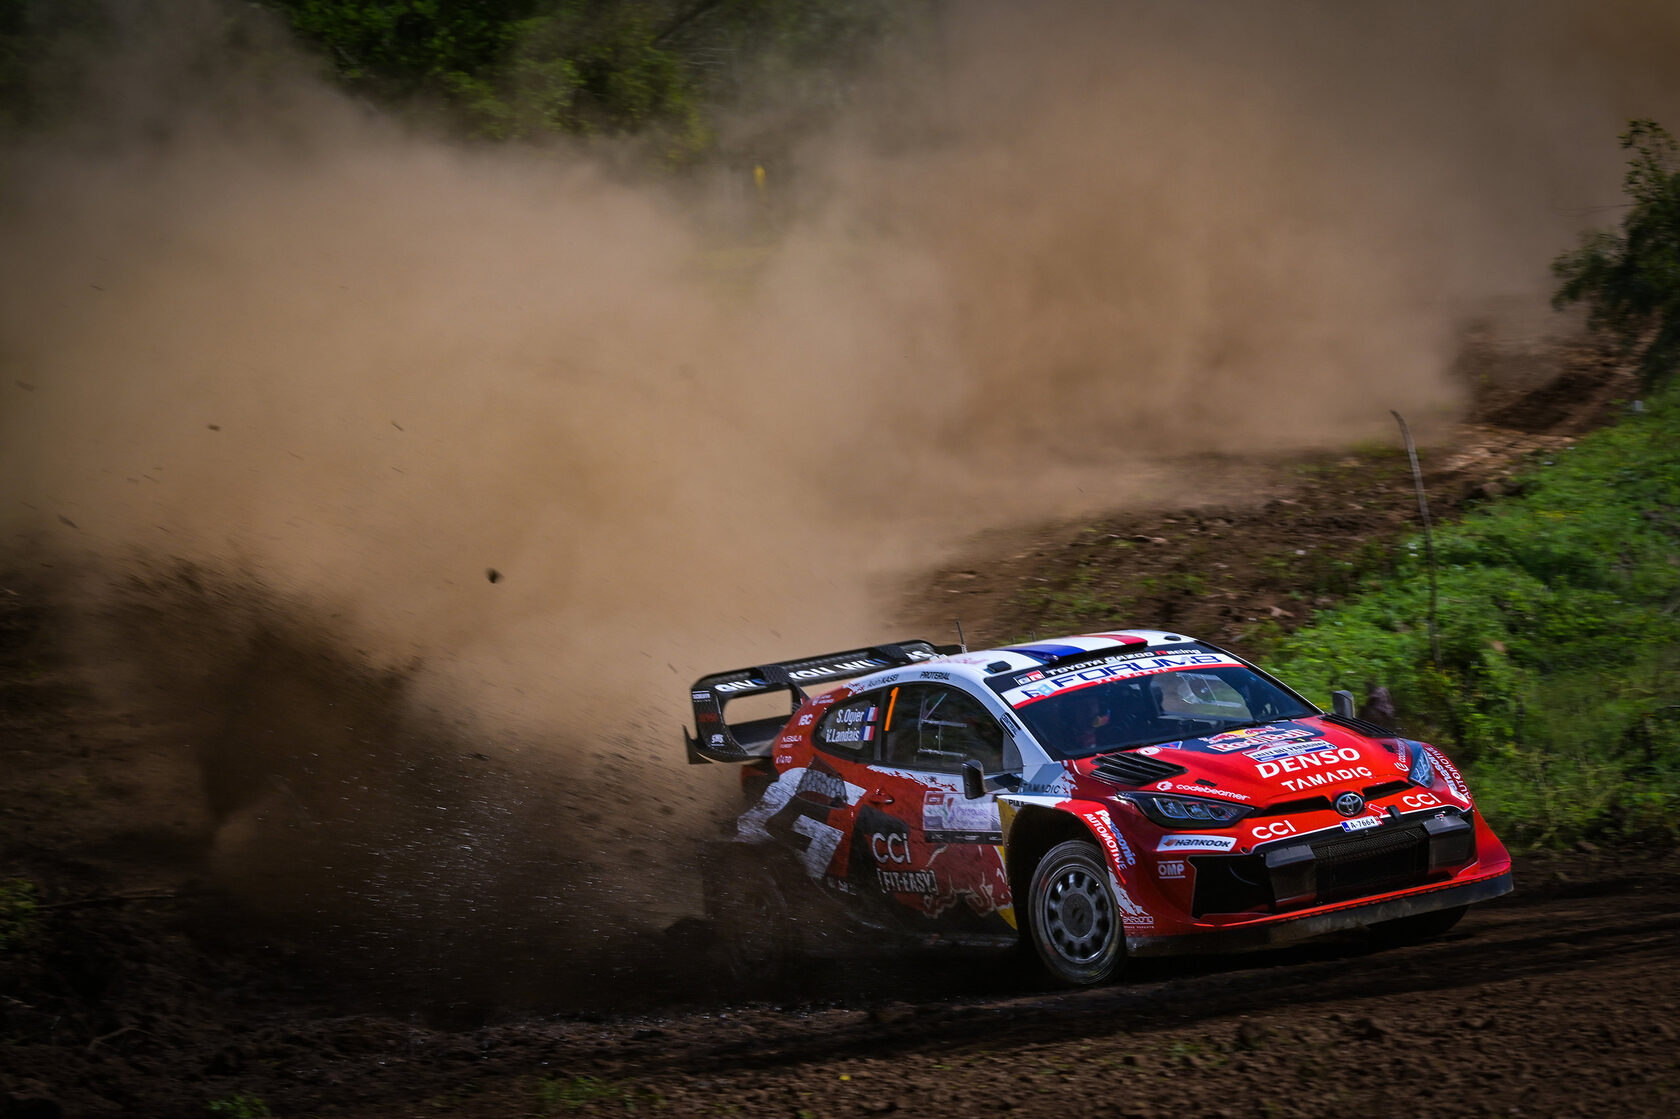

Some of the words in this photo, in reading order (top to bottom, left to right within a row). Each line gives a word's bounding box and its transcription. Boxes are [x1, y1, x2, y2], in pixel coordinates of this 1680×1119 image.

[1045, 660, 1101, 676] TOYOTA
[1050, 654, 1223, 688] FORUM8
[884, 686, 900, 732] 1
[1207, 735, 1262, 752] Red
[1261, 728, 1316, 743] Bull
[1255, 747, 1361, 779] DENSO
[1280, 766, 1373, 792] TAMADIC
[1175, 784, 1252, 801] codebeamer
[1402, 792, 1442, 808] CCI
[1082, 812, 1128, 871] AUTOMOTIVE
[1094, 808, 1136, 867] Panasonic
[1251, 819, 1297, 841] CCI
[1157, 863, 1185, 876] OMP
